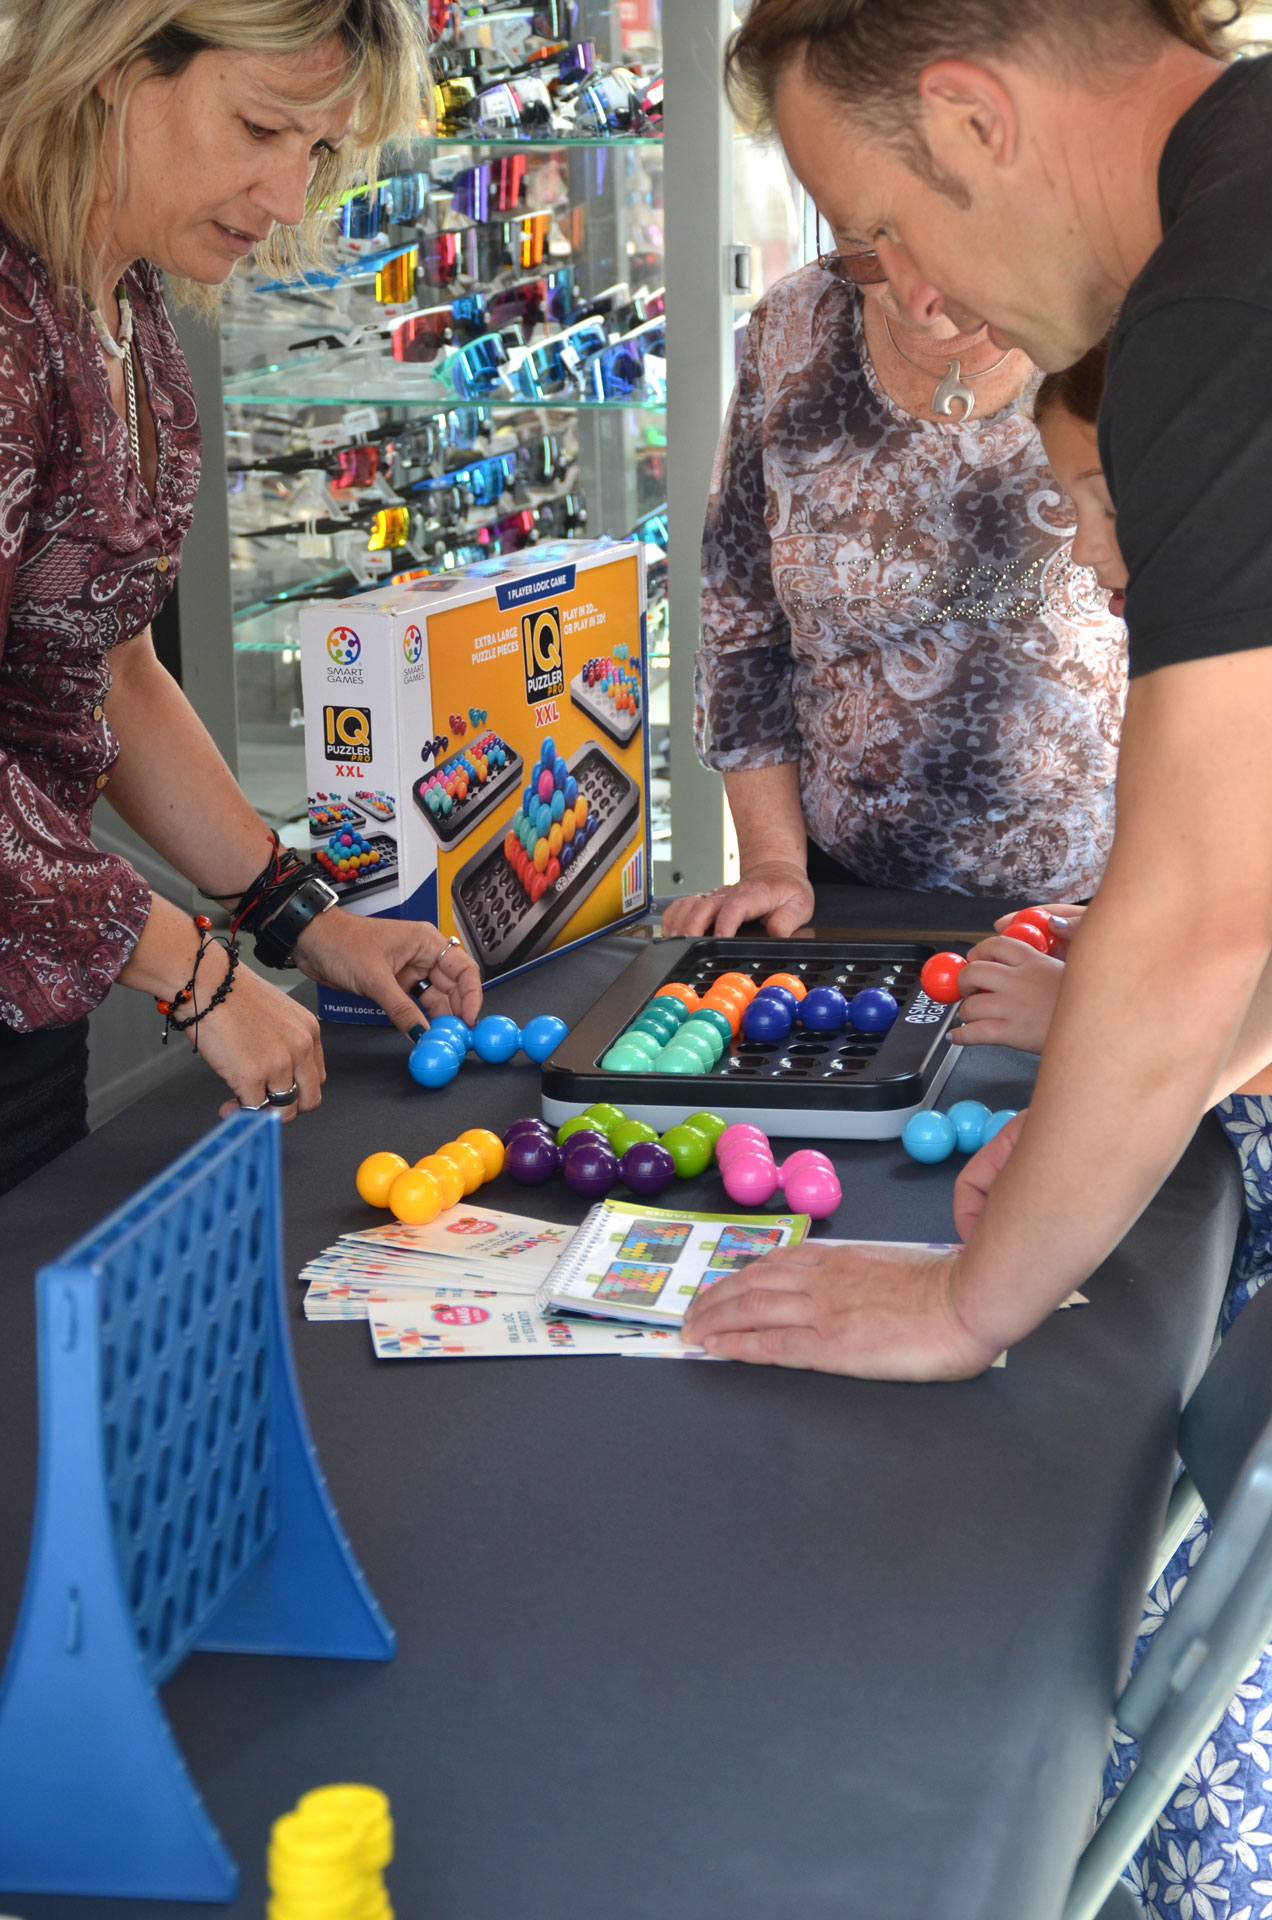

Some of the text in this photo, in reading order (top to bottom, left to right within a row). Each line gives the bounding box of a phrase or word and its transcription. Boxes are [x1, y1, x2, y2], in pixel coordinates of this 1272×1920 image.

[507, 574, 567, 600] 1 PLAYER LOGIC GAME
[562, 608, 578, 622] PLAY
[578, 606, 585, 617] IN
[564, 612, 606, 635] OR PLAY IN 3D!
[474, 626, 518, 650] EXTRA LARGE
[524, 612, 562, 678] IQ
[472, 640, 519, 664] PUZZLE PIECES
[326, 666, 364, 676] SMART
[403, 664, 424, 677] SMART
[326, 676, 364, 685] GAMES
[403, 672, 425, 685] GAMES
[527, 670, 563, 694] PUZZLER
[547, 683, 564, 697] PRO
[535, 702, 560, 728] XXL
[326, 707, 370, 746] IQ
[327, 745, 370, 756] PUZZLER
[351, 755, 371, 763] PRO
[336, 765, 364, 778] XXL
[354, 1007, 375, 1015] LOGIC
[457, 1307, 470, 1324] MAIG
[502, 1312, 516, 1324] JOC
[508, 1333, 521, 1343] FIRA
